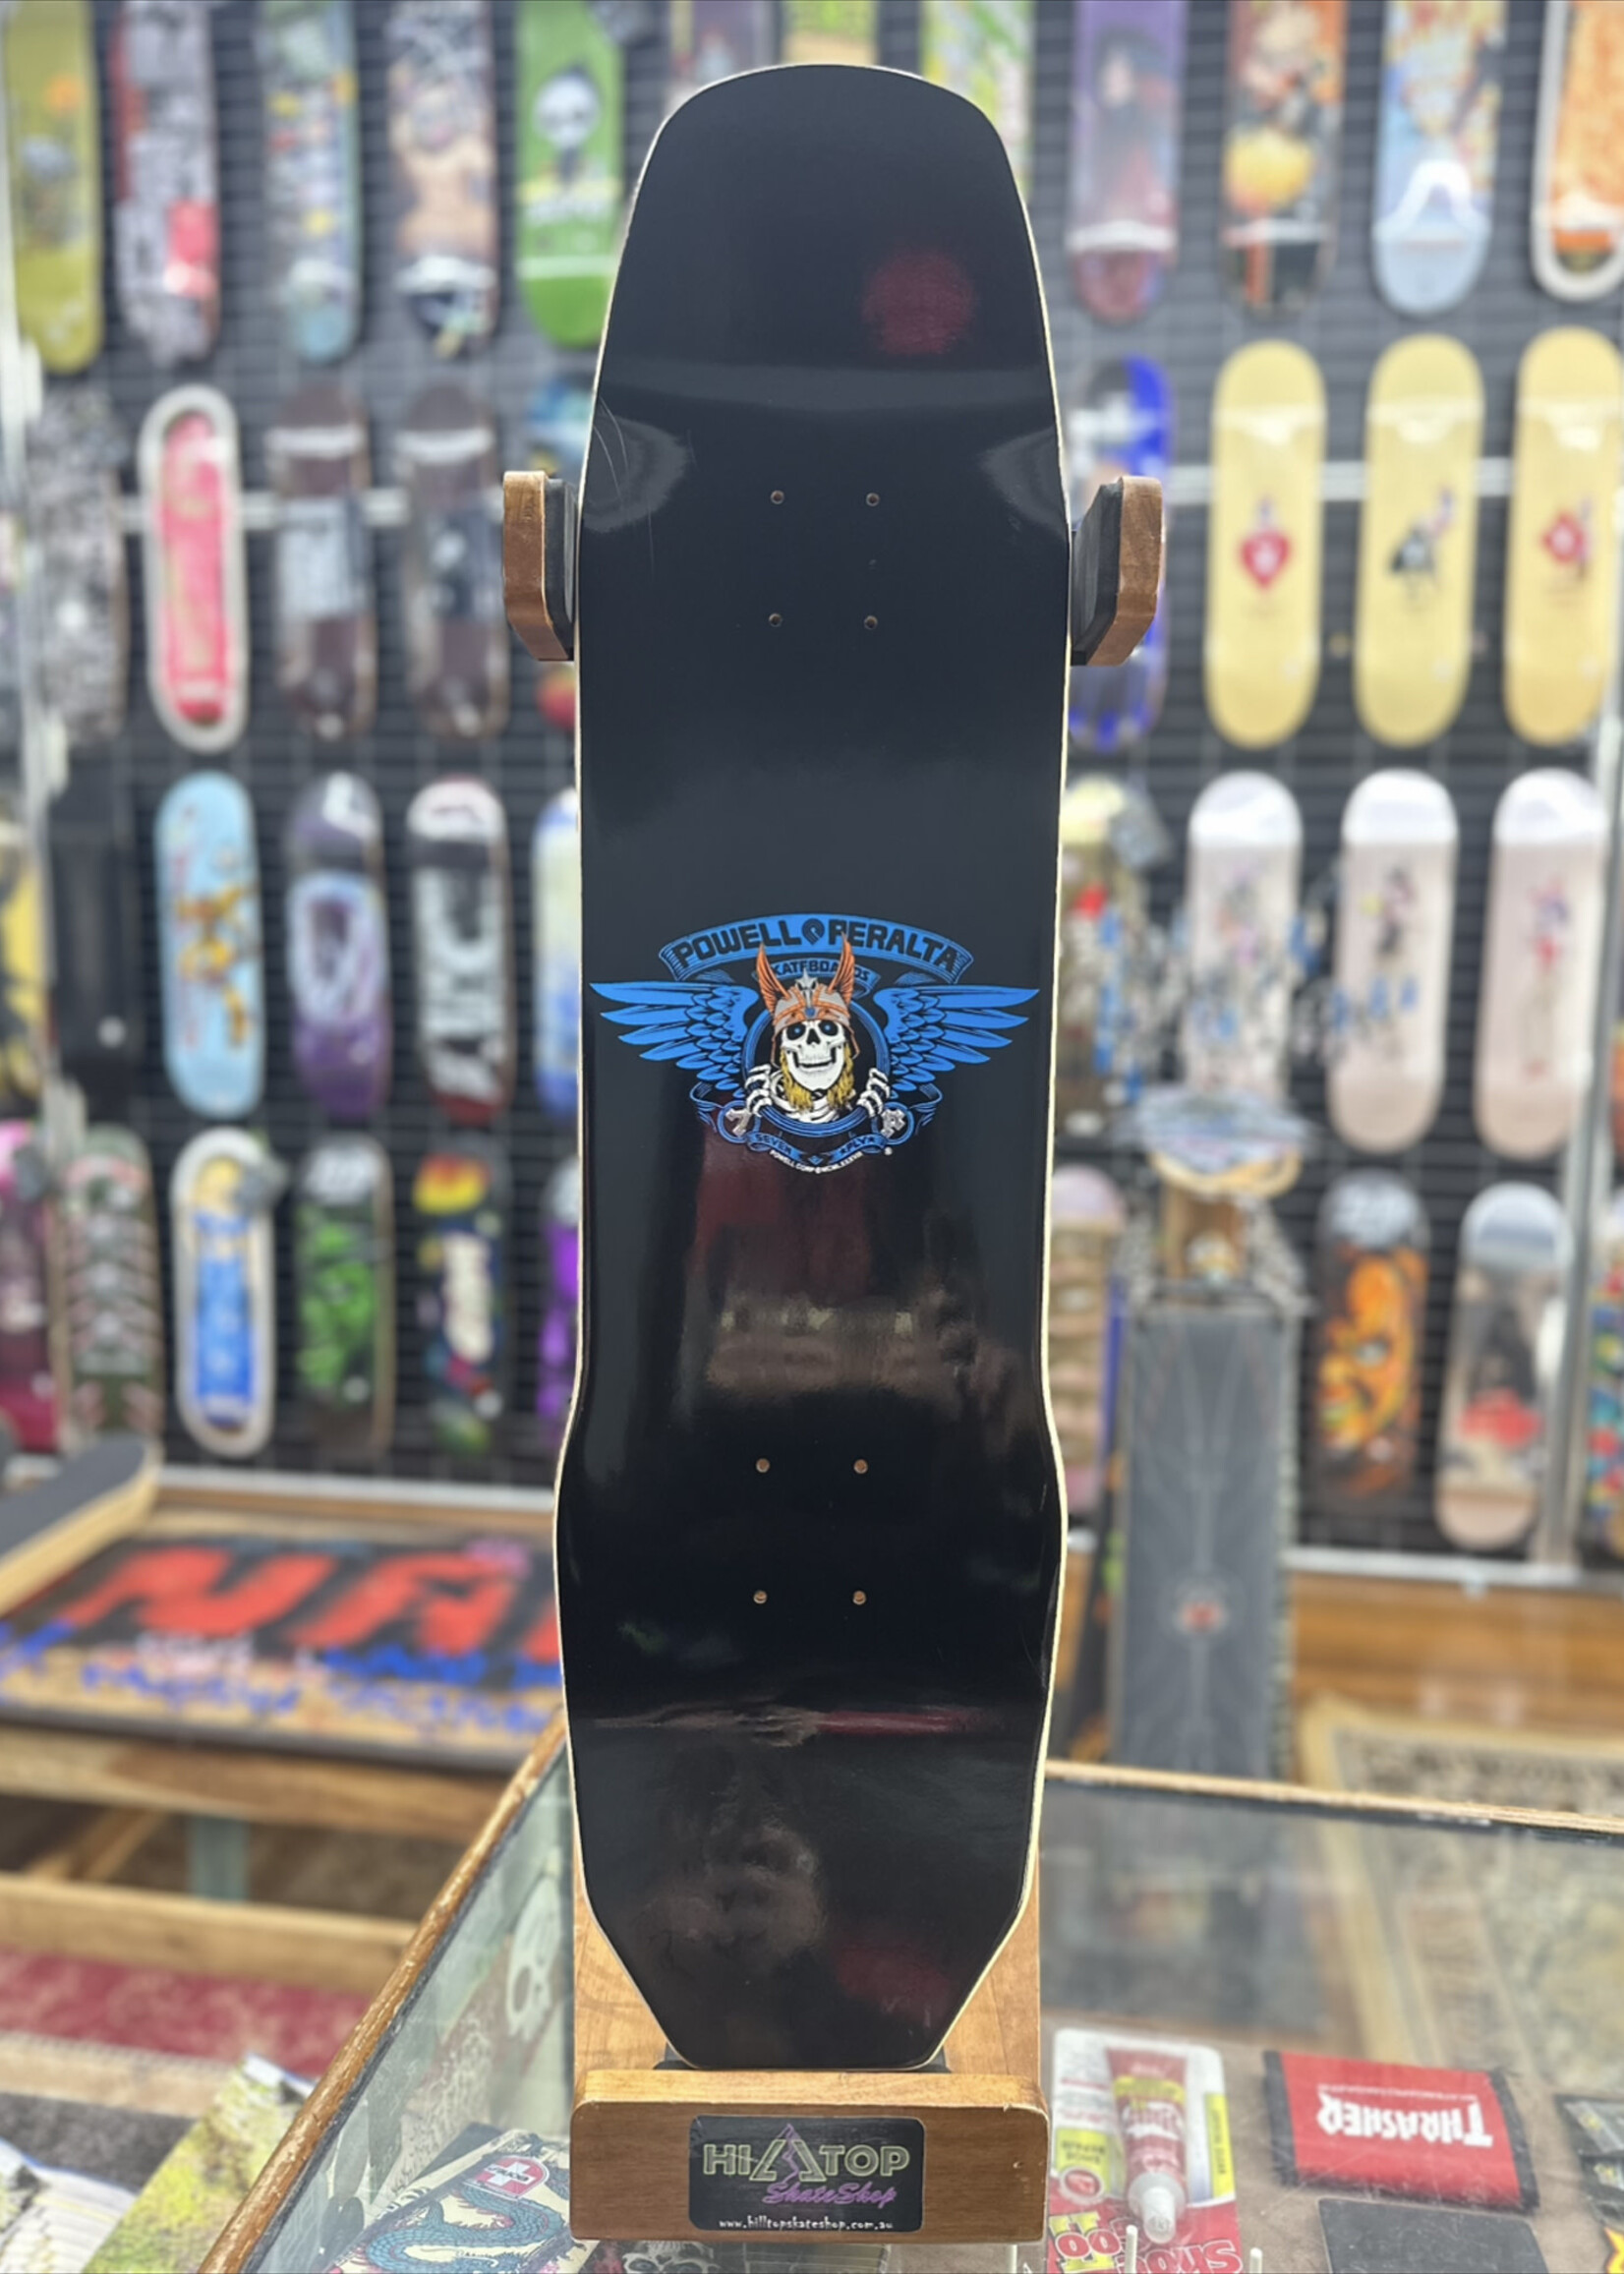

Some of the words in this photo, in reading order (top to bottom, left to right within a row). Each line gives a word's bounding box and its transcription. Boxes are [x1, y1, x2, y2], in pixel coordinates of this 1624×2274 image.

[675, 920, 801, 968] POWELL
[828, 918, 957, 972] PERALTA
[1316, 2091, 1493, 2148] THRASHER
[719, 2215, 894, 2233] www.hilltopskateshop.com.au
